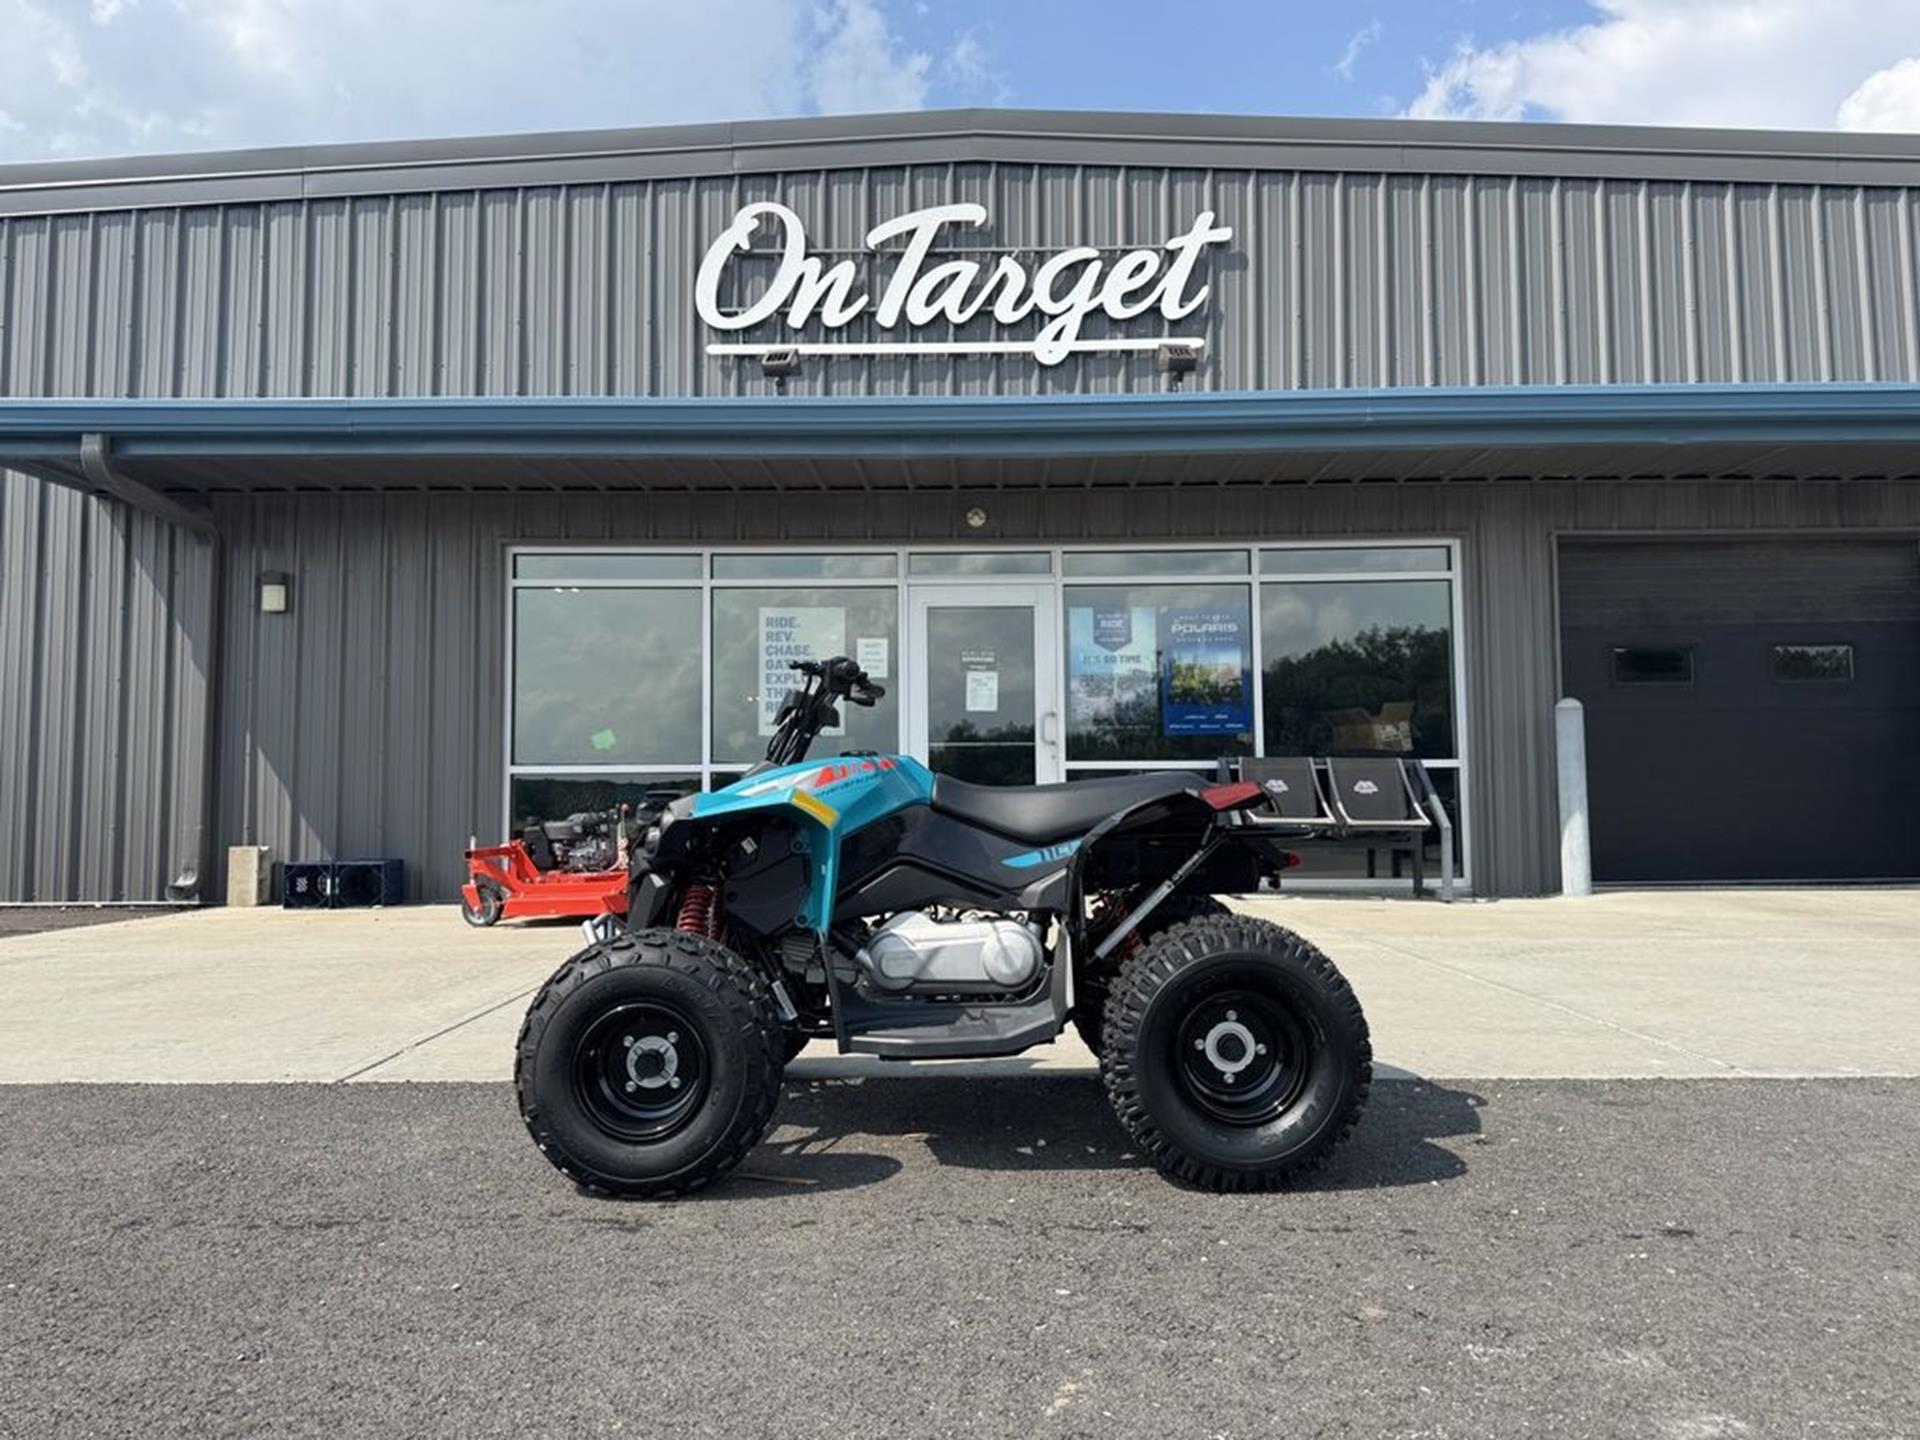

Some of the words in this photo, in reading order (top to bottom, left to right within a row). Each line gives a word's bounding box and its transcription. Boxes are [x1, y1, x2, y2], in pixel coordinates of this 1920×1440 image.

[695, 201, 868, 330] On
[866, 203, 1233, 366] Target
[765, 616, 800, 629] RIDE.
[1171, 622, 1239, 633] POLARIS
[765, 631, 796, 643] REV.
[765, 644, 812, 657] CHASE.
